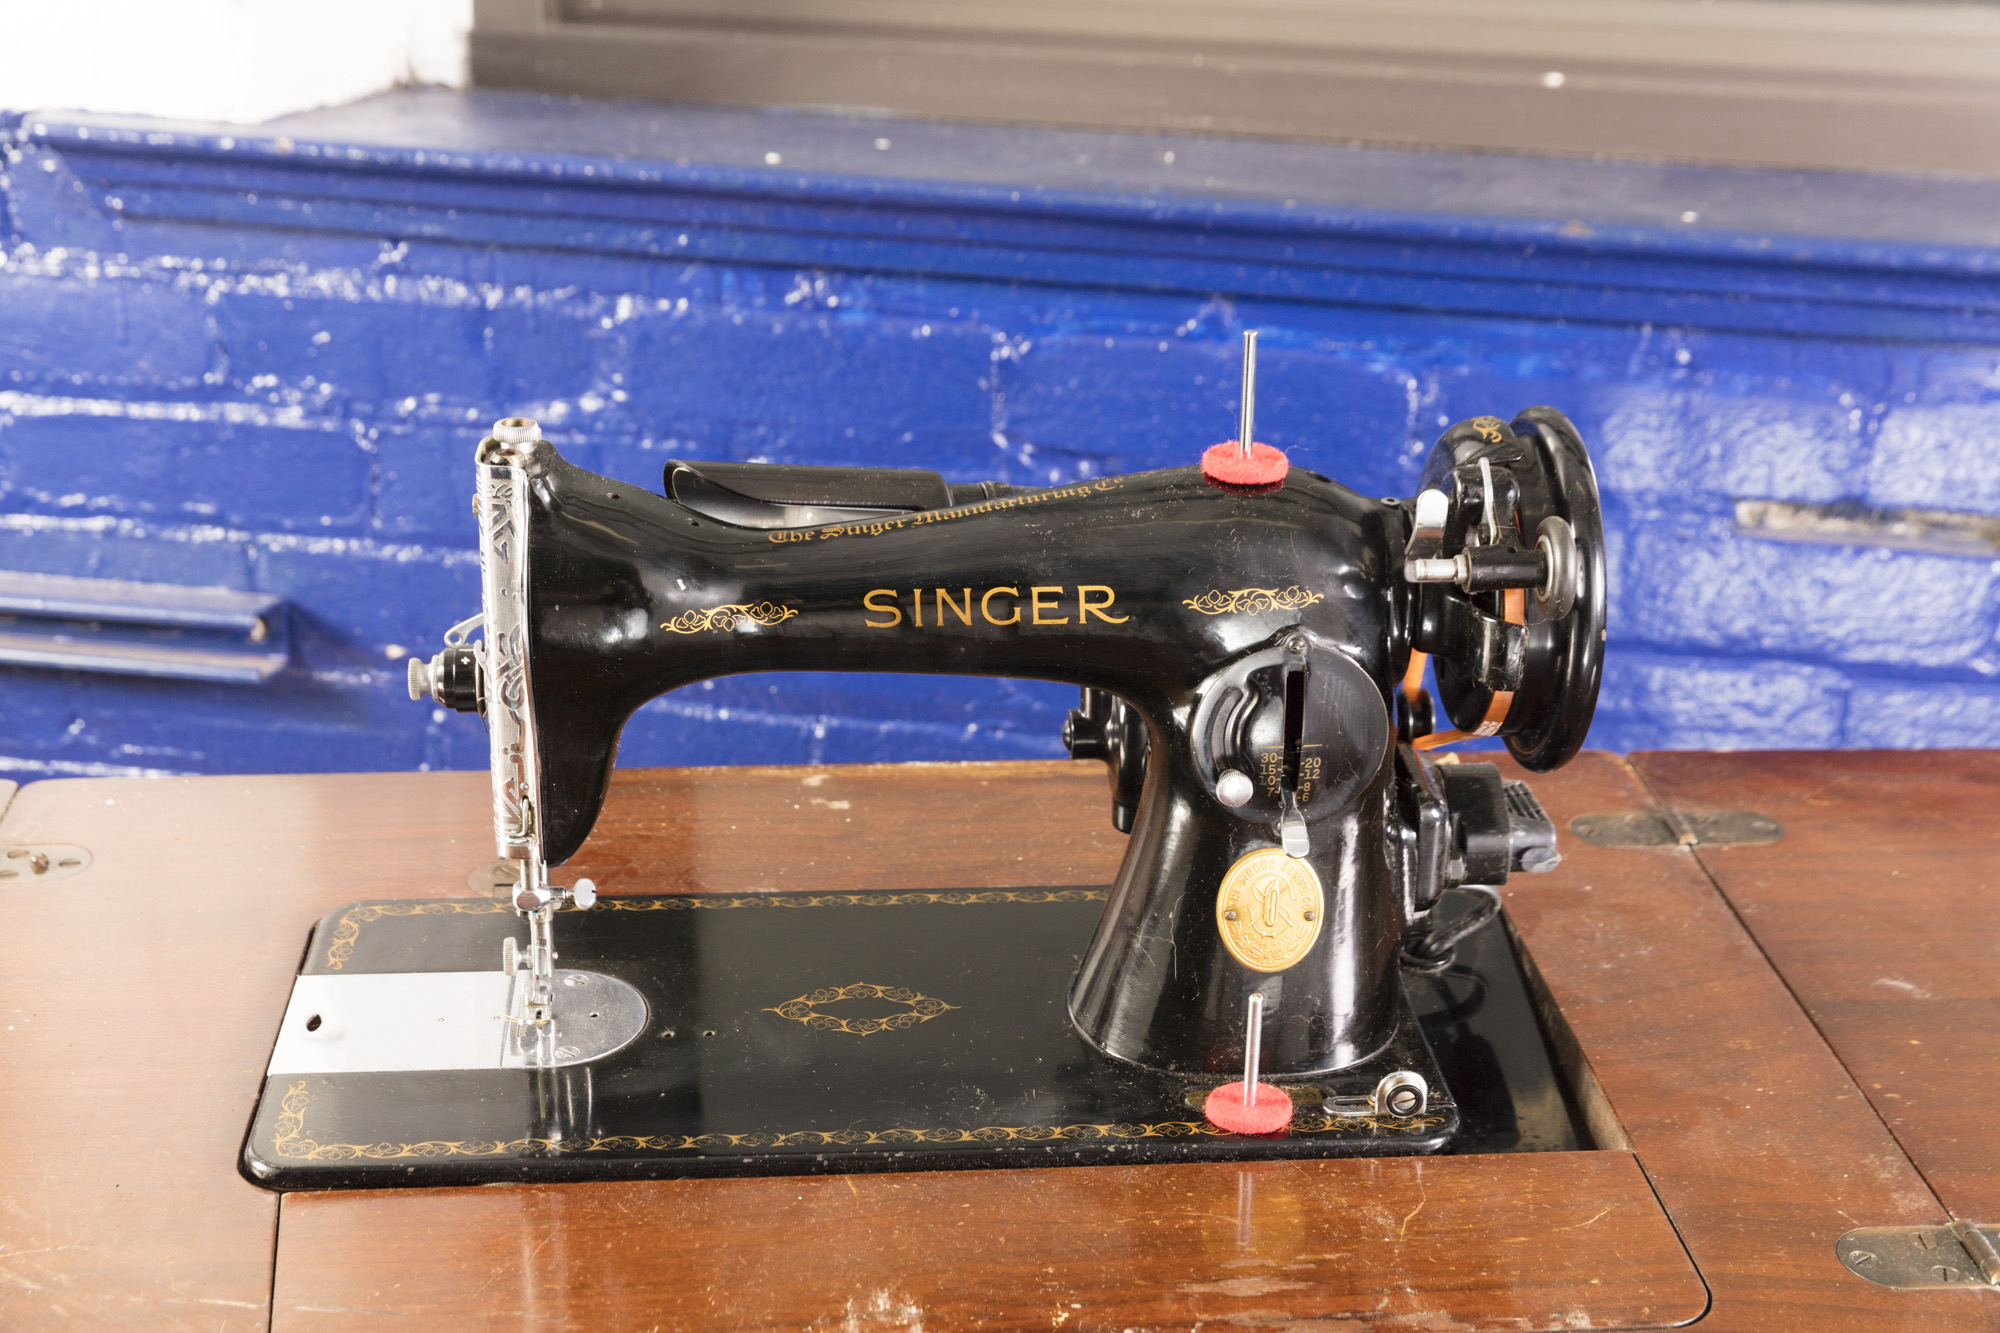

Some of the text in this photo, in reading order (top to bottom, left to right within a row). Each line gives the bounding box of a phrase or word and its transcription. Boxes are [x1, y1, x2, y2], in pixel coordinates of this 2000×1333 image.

[767, 529, 816, 544] The
[819, 518, 908, 540] Singer
[911, 485, 1093, 528] Manufacturing
[863, 585, 1130, 628] SINGER
[1260, 752, 1278, 763] 30
[1304, 757, 1322, 769] 20
[1259, 764, 1277, 775] 15
[1303, 768, 1321, 780] 12
[1258, 775, 1276, 786] 10
[1303, 781, 1311, 792] 8
[1267, 787, 1275, 798] 7
[1302, 792, 1310, 802] 6
[1239, 859, 1276, 886] SINGER
